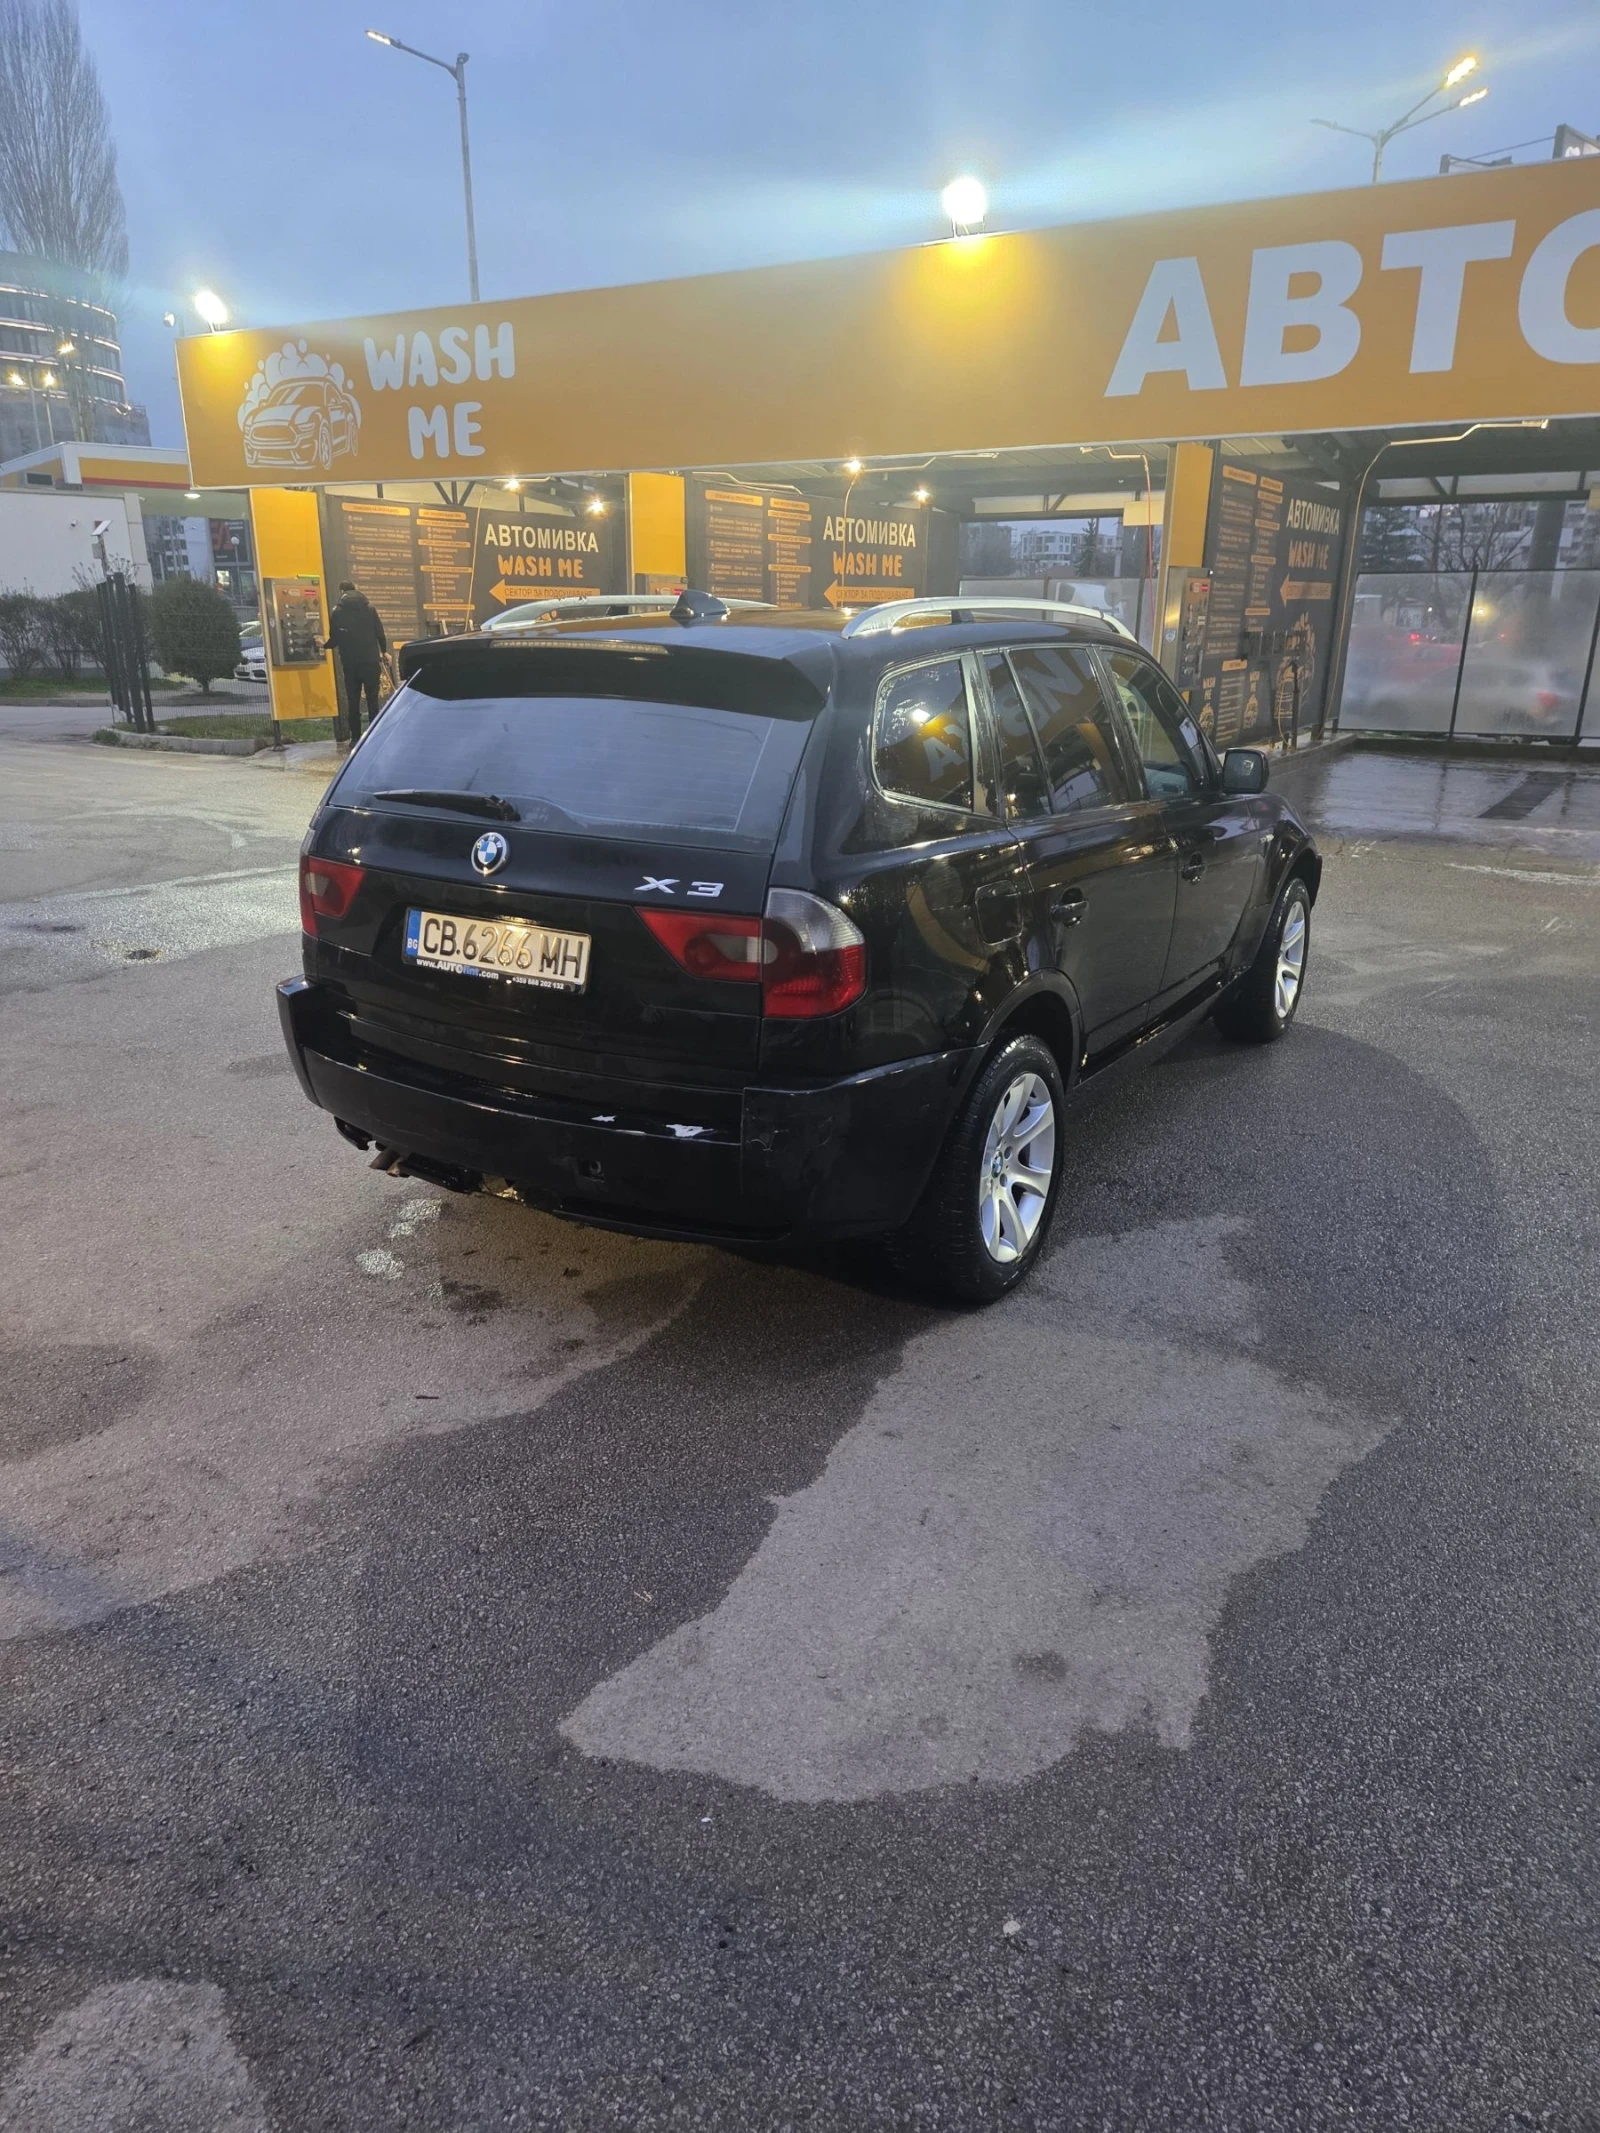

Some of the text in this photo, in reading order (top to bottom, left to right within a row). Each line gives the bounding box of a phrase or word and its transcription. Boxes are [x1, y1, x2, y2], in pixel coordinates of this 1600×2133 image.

[363, 321, 515, 391] WASH
[407, 401, 486, 460] ME
[823, 515, 916, 548] АВТОМИВКА
[1286, 498, 1341, 536] АВТОМИВКА
[484, 523, 600, 553] АВТОМИВКА
[497, 554, 584, 579] WASH ME
[833, 550, 903, 577] WASH ME
[1288, 539, 1316, 569] WASH
[406, 937, 419, 950] BG
[538, 933, 584, 979] MH
